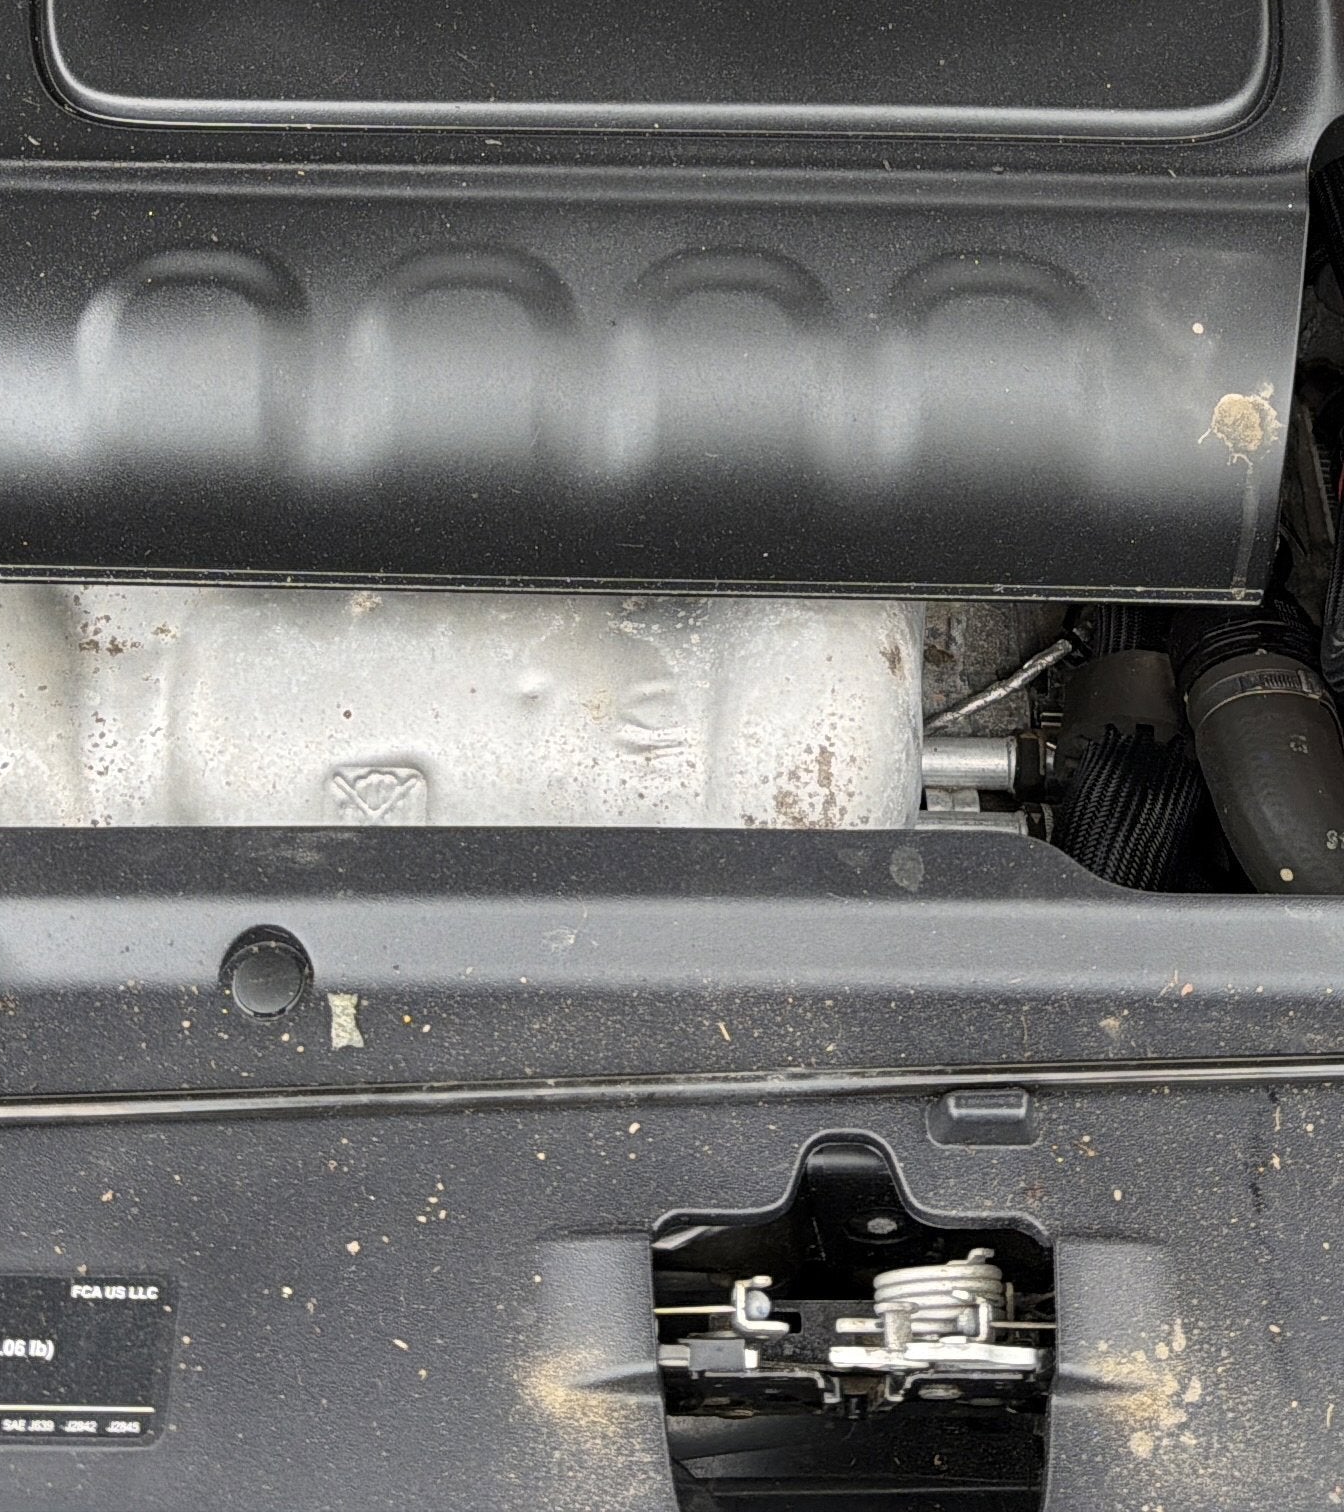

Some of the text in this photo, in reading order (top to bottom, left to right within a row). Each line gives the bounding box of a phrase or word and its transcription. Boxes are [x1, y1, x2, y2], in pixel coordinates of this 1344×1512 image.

[71, 1285, 159, 1300] FCA US LLC
[28, 1338, 55, 1361] lb)
[1, 1419, 27, 1432] SAE
